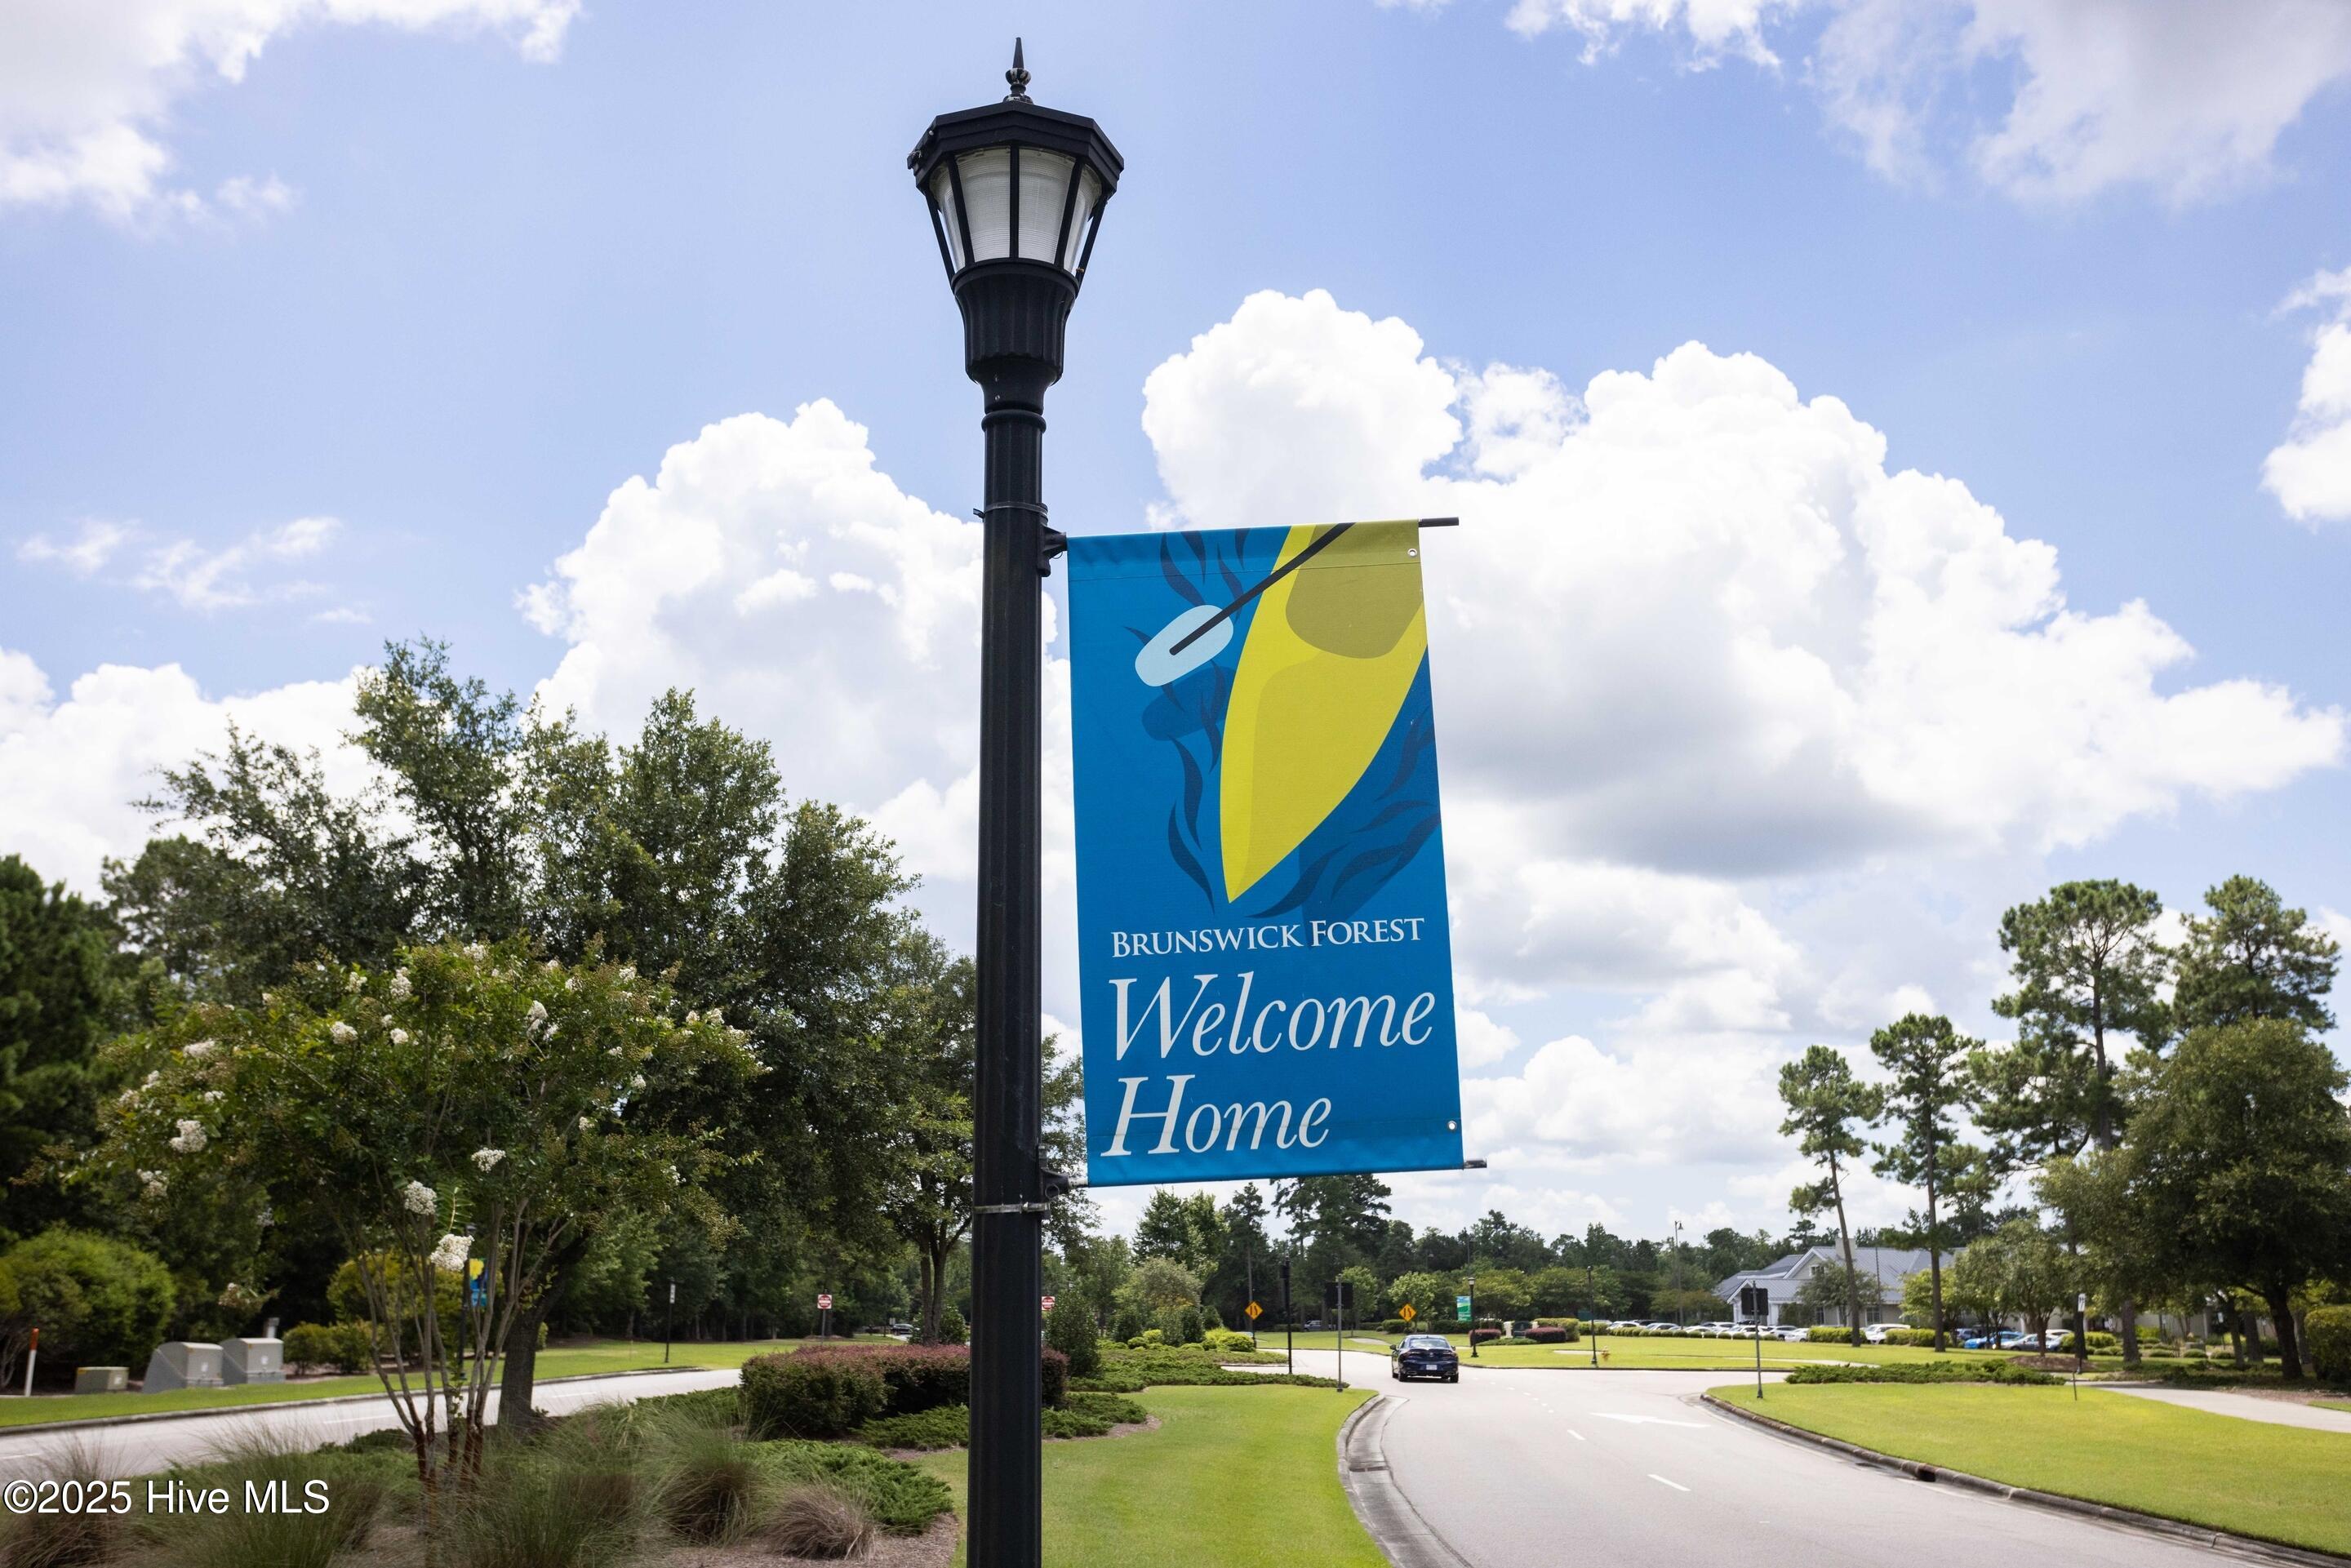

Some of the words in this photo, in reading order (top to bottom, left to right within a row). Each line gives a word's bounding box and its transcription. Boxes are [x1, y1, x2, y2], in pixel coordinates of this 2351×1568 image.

[1111, 925, 1304, 958] BRUNSWICK
[1309, 917, 1425, 947] FOREST
[1108, 971, 1436, 1061] Welcome
[1100, 1074, 1332, 1157] Home
